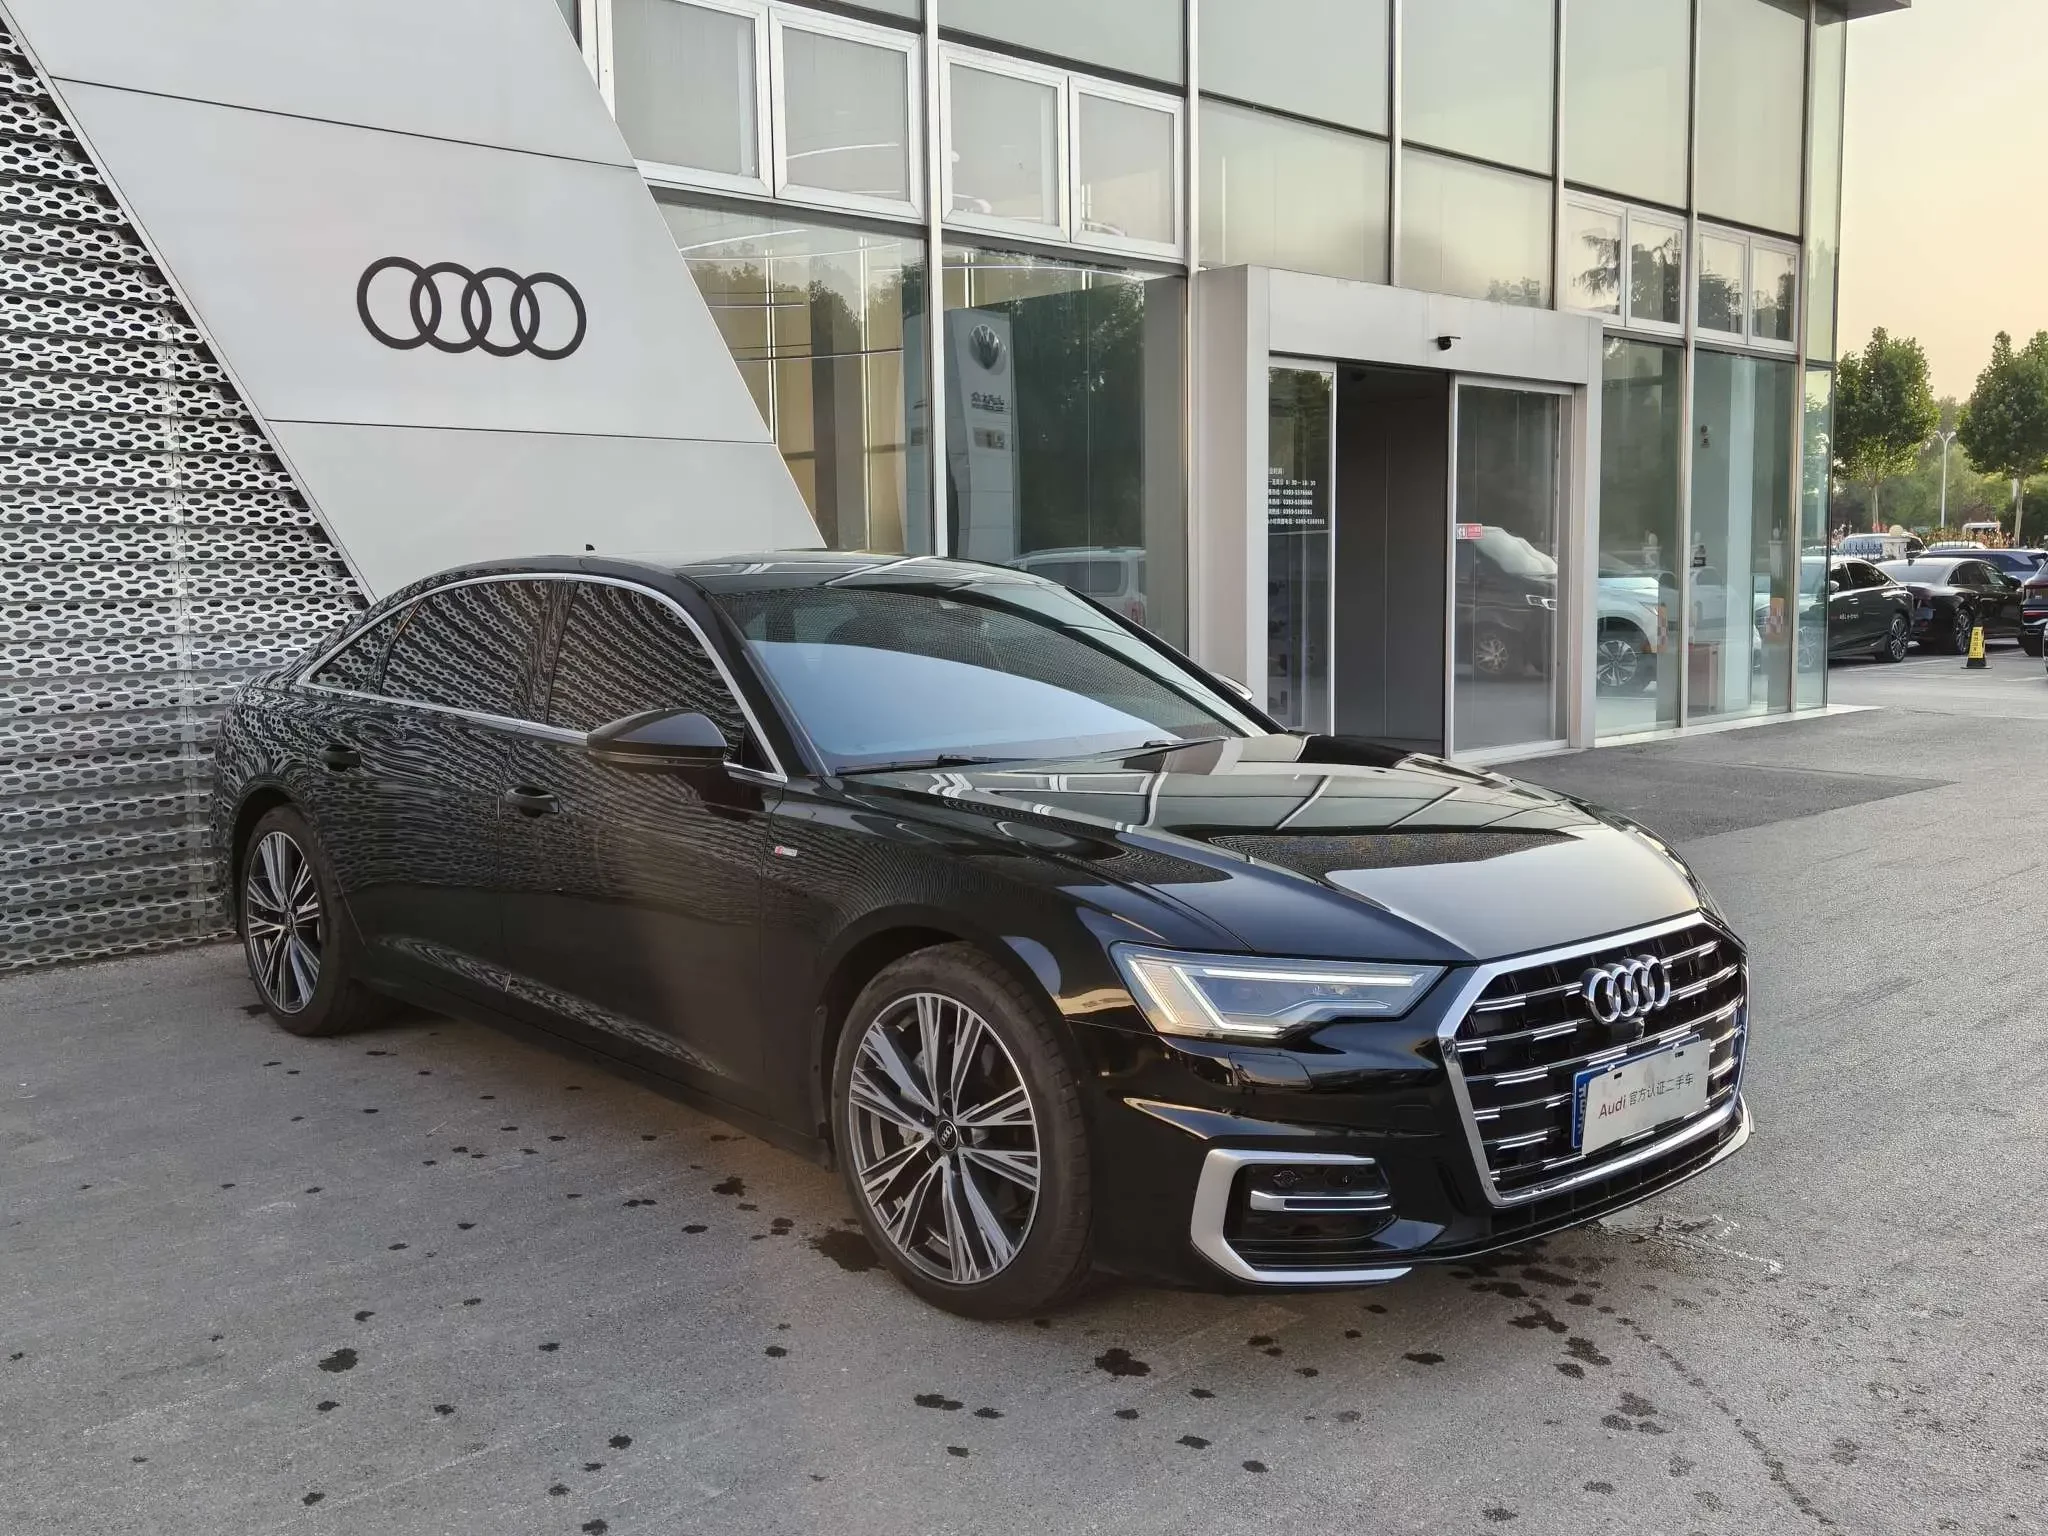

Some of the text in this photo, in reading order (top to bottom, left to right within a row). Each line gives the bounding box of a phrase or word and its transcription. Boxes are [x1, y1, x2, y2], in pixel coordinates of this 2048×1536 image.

[1598, 1094, 1627, 1119] Audi
[1629, 1072, 1694, 1106] 官方认证二手车
